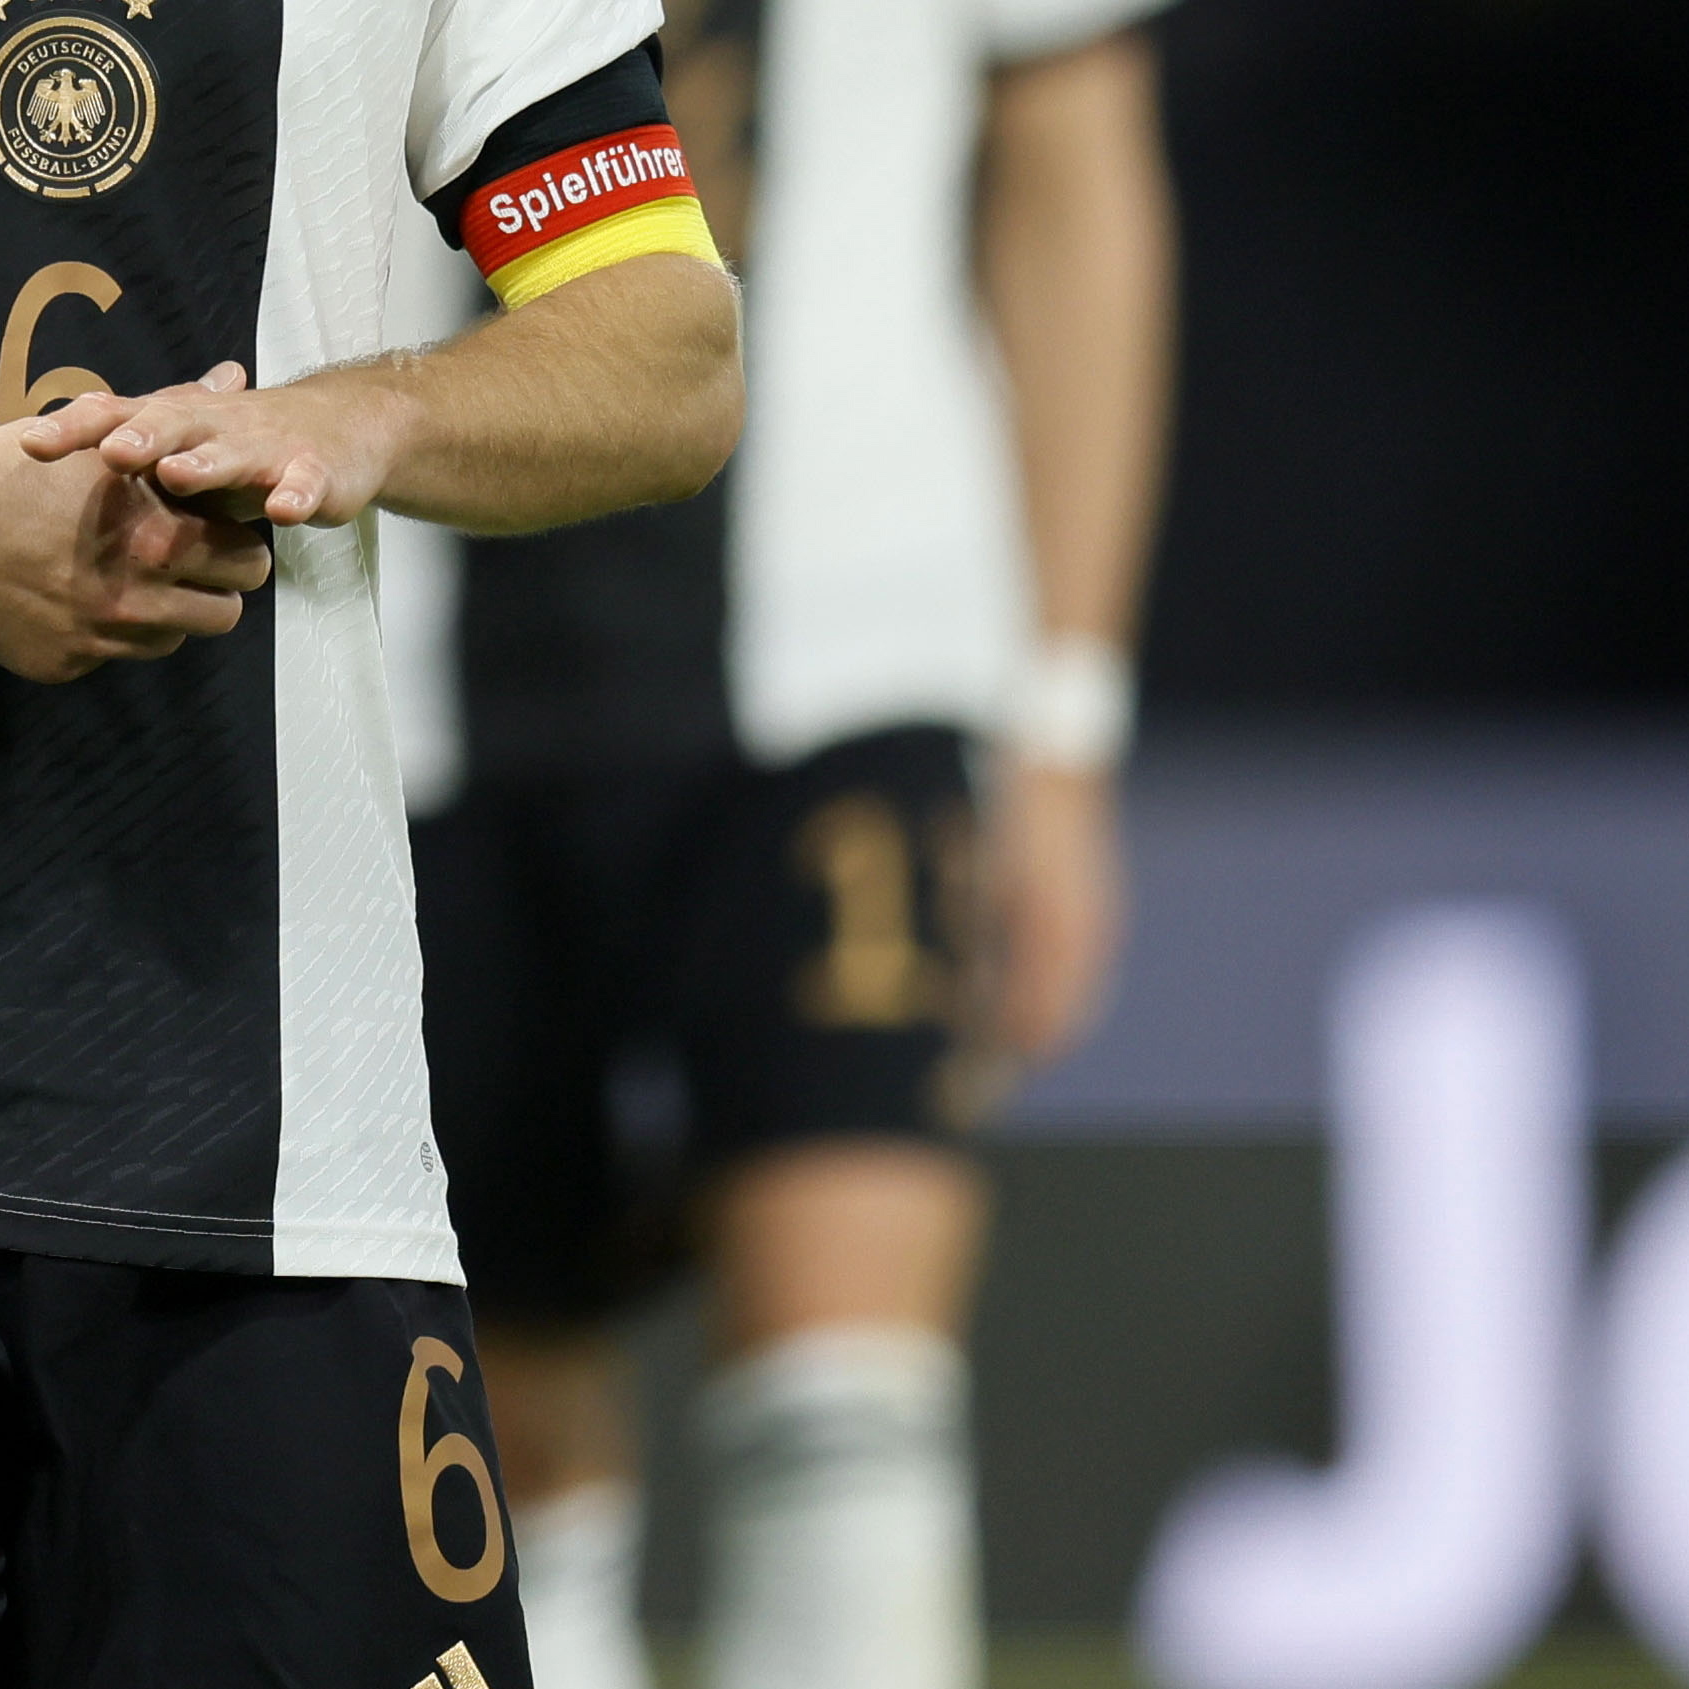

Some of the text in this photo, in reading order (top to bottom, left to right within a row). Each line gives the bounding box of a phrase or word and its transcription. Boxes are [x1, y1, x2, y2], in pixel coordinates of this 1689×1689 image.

[16, 40, 115, 75] DEUTSCHER
[7, 125, 128, 175] FUSSBALL-BUND
[489, 143, 686, 235] Spielführer
[398, 1335, 505, 1603] 6
